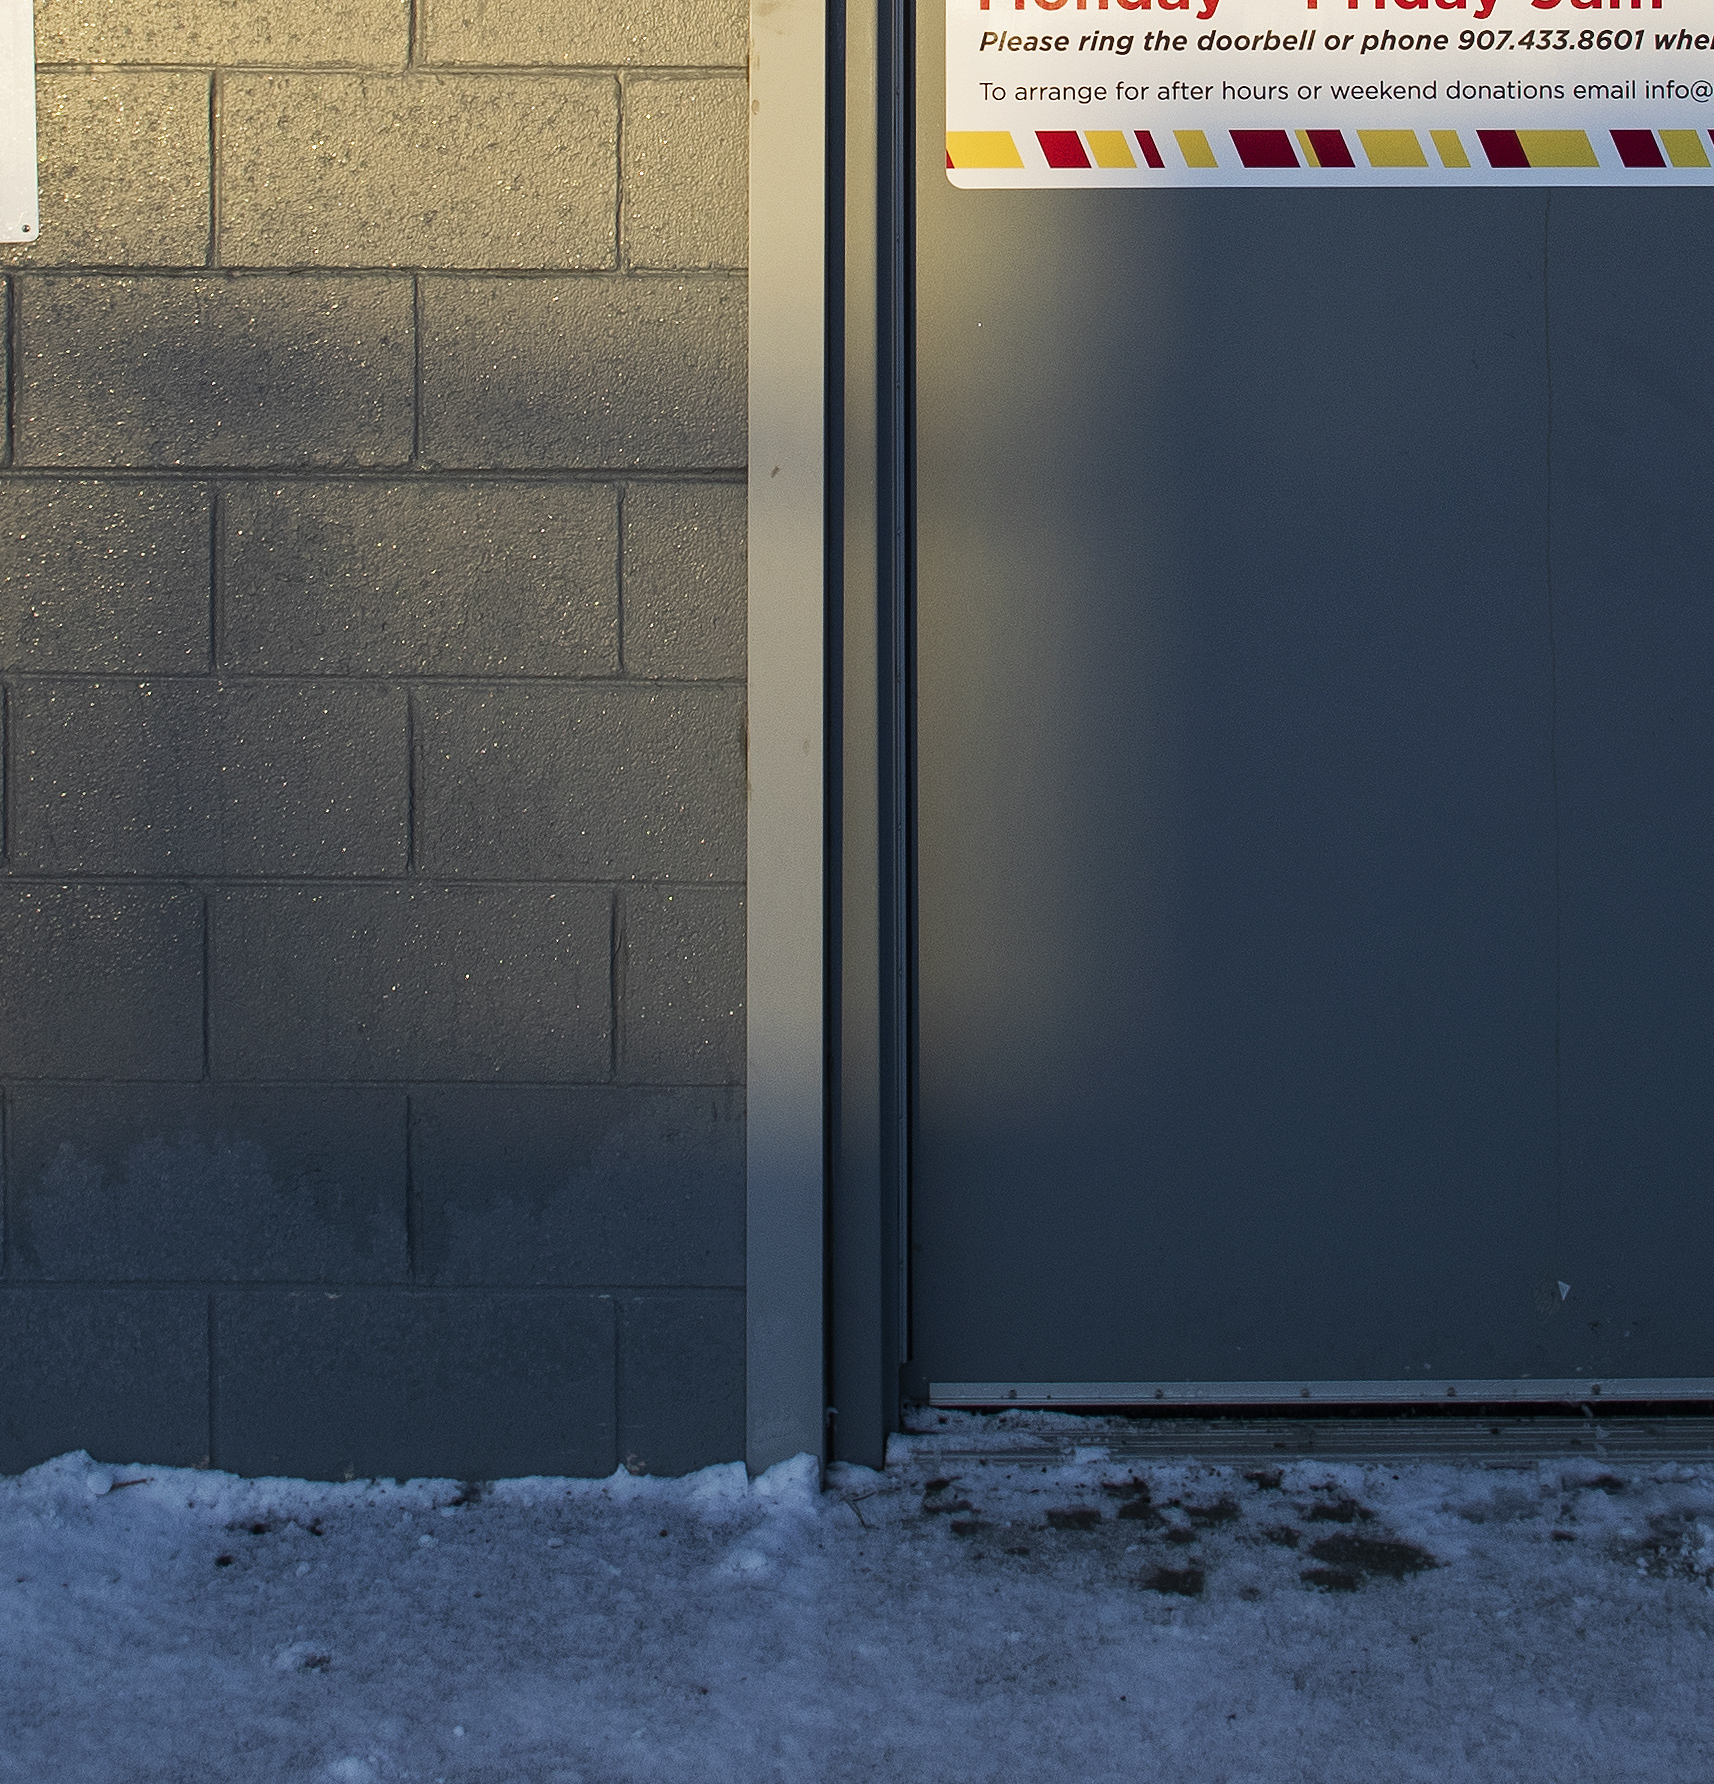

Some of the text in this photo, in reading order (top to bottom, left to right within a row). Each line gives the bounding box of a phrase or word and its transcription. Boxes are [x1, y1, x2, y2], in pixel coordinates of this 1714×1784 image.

[979, 31, 1070, 52] Please
[1078, 29, 1135, 56] ring
[1143, 29, 1188, 52] the
[1197, 29, 1317, 51] doorbell
[1324, 34, 1355, 51] or
[1359, 29, 1449, 55] phone
[1457, 29, 1645, 51] 907.433.8601
[979, 82, 1007, 101] To
[1014, 86, 1108, 105] arrange
[1115, 80, 1150, 101] for
[1157, 80, 1214, 101] after
[1222, 80, 1289, 101] hours
[1297, 85, 1323, 101] or
[1330, 79, 1437, 100] weekend
[1446, 79, 1565, 100] donations
[1573, 79, 1636, 100] email
